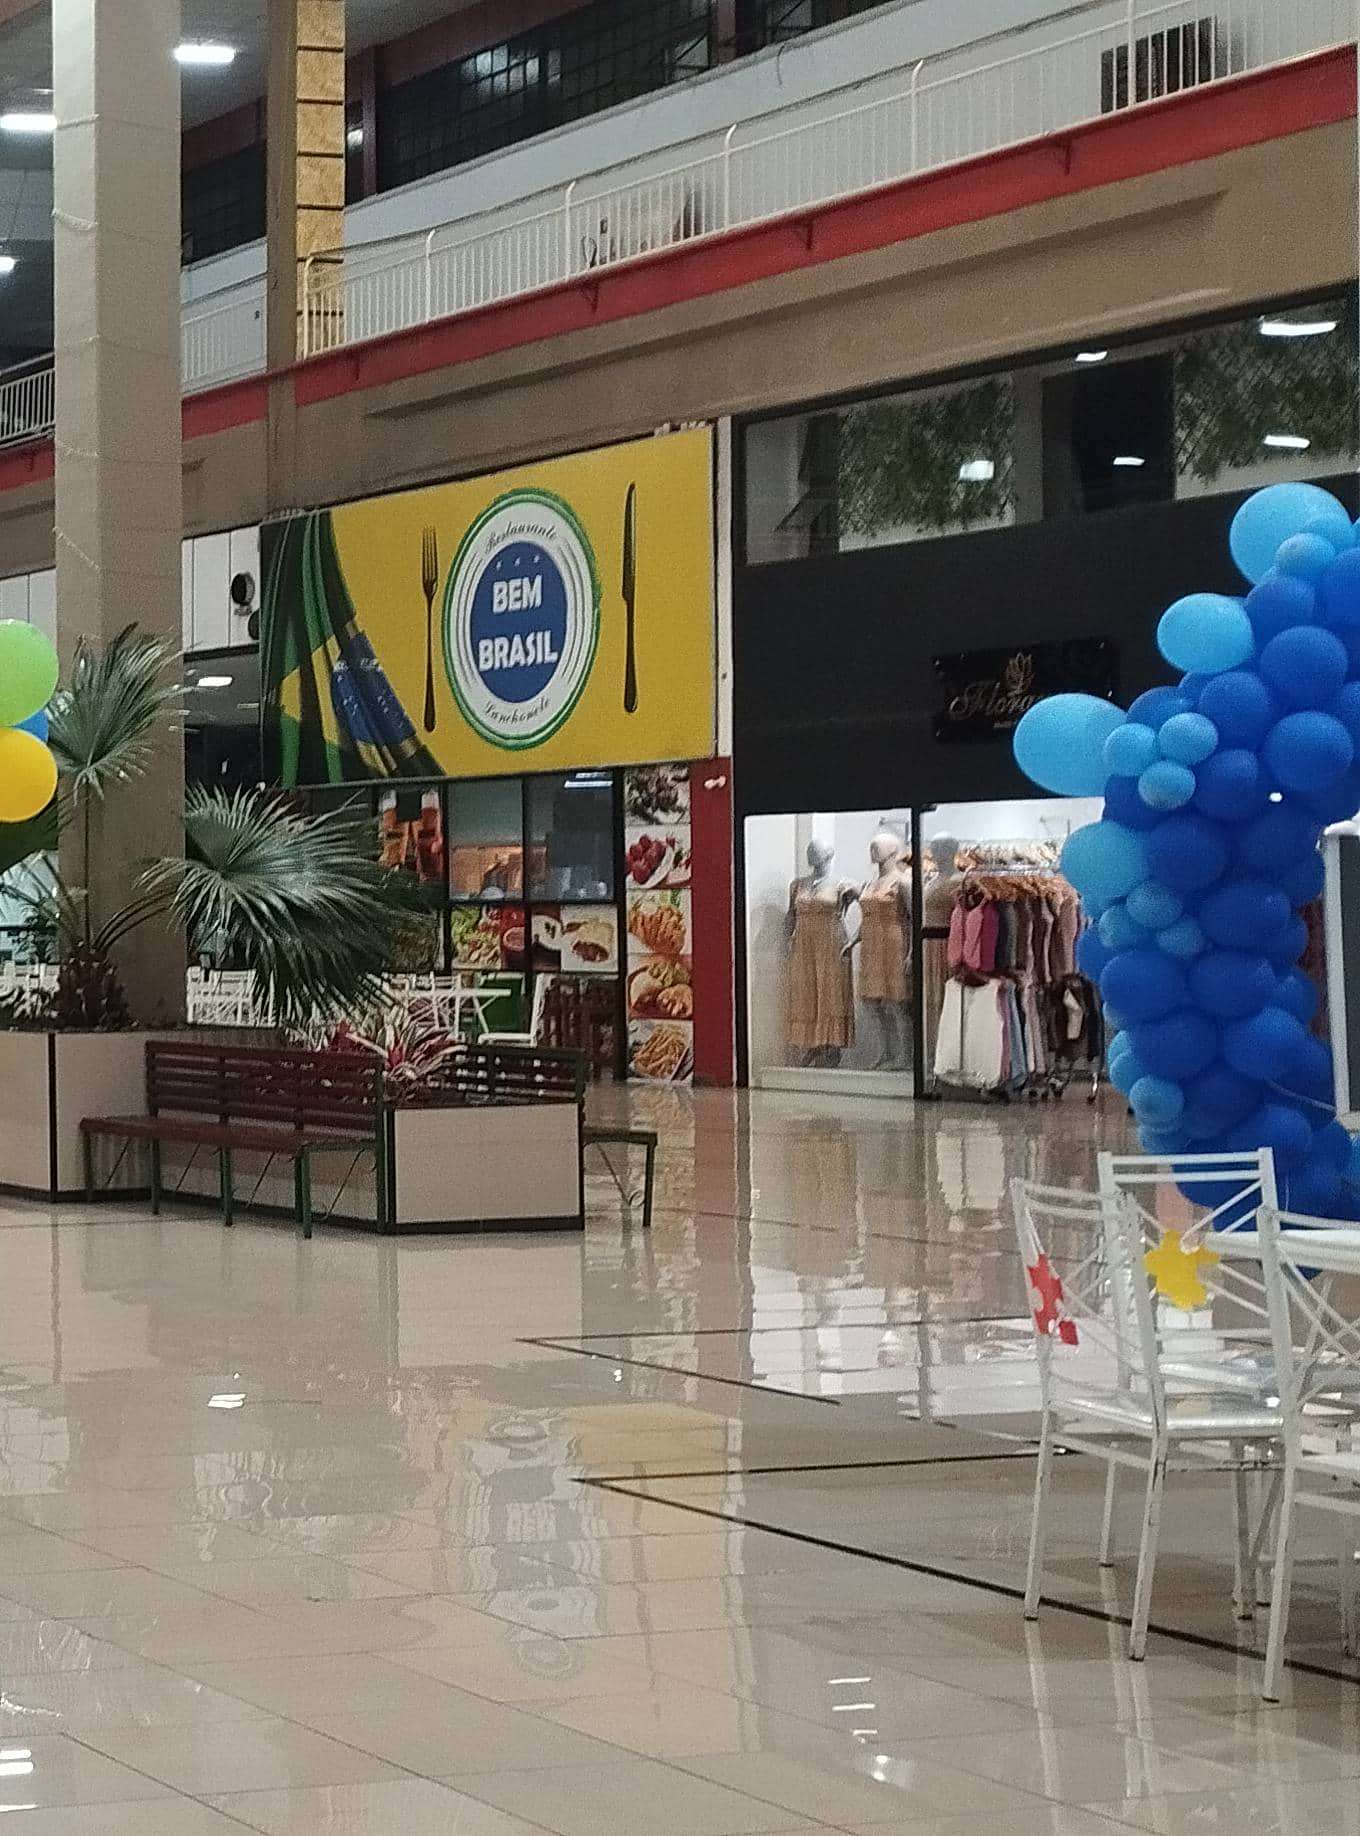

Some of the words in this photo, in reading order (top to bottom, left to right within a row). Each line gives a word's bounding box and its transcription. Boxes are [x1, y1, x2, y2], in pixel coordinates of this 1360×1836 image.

[485, 521, 559, 554] Restaurante
[492, 575, 543, 614] BEM
[478, 630, 558, 671] BRASIL
